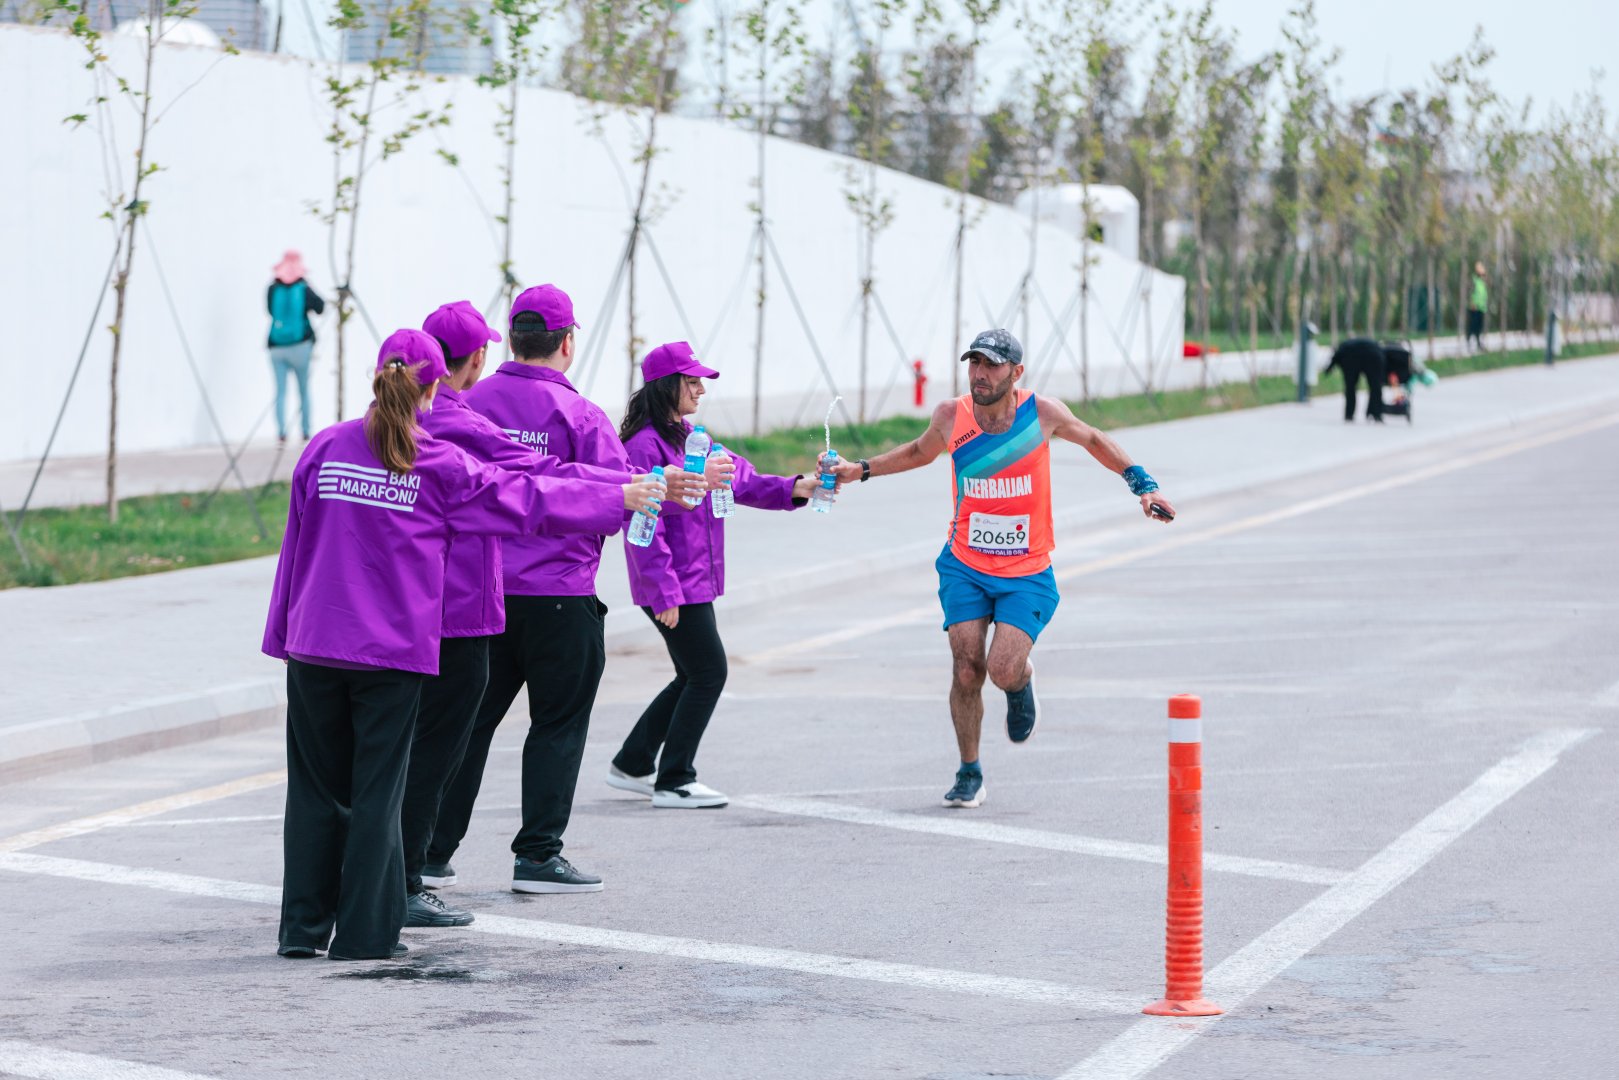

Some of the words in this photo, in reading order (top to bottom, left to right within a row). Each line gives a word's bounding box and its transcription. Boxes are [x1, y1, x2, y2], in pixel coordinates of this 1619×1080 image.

[521, 430, 549, 445] BAKI
[389, 471, 421, 490] BAKI
[963, 474, 1032, 499] AZERBAIJAN
[340, 478, 418, 505] MARAFONU
[972, 529, 1026, 545] 20659
